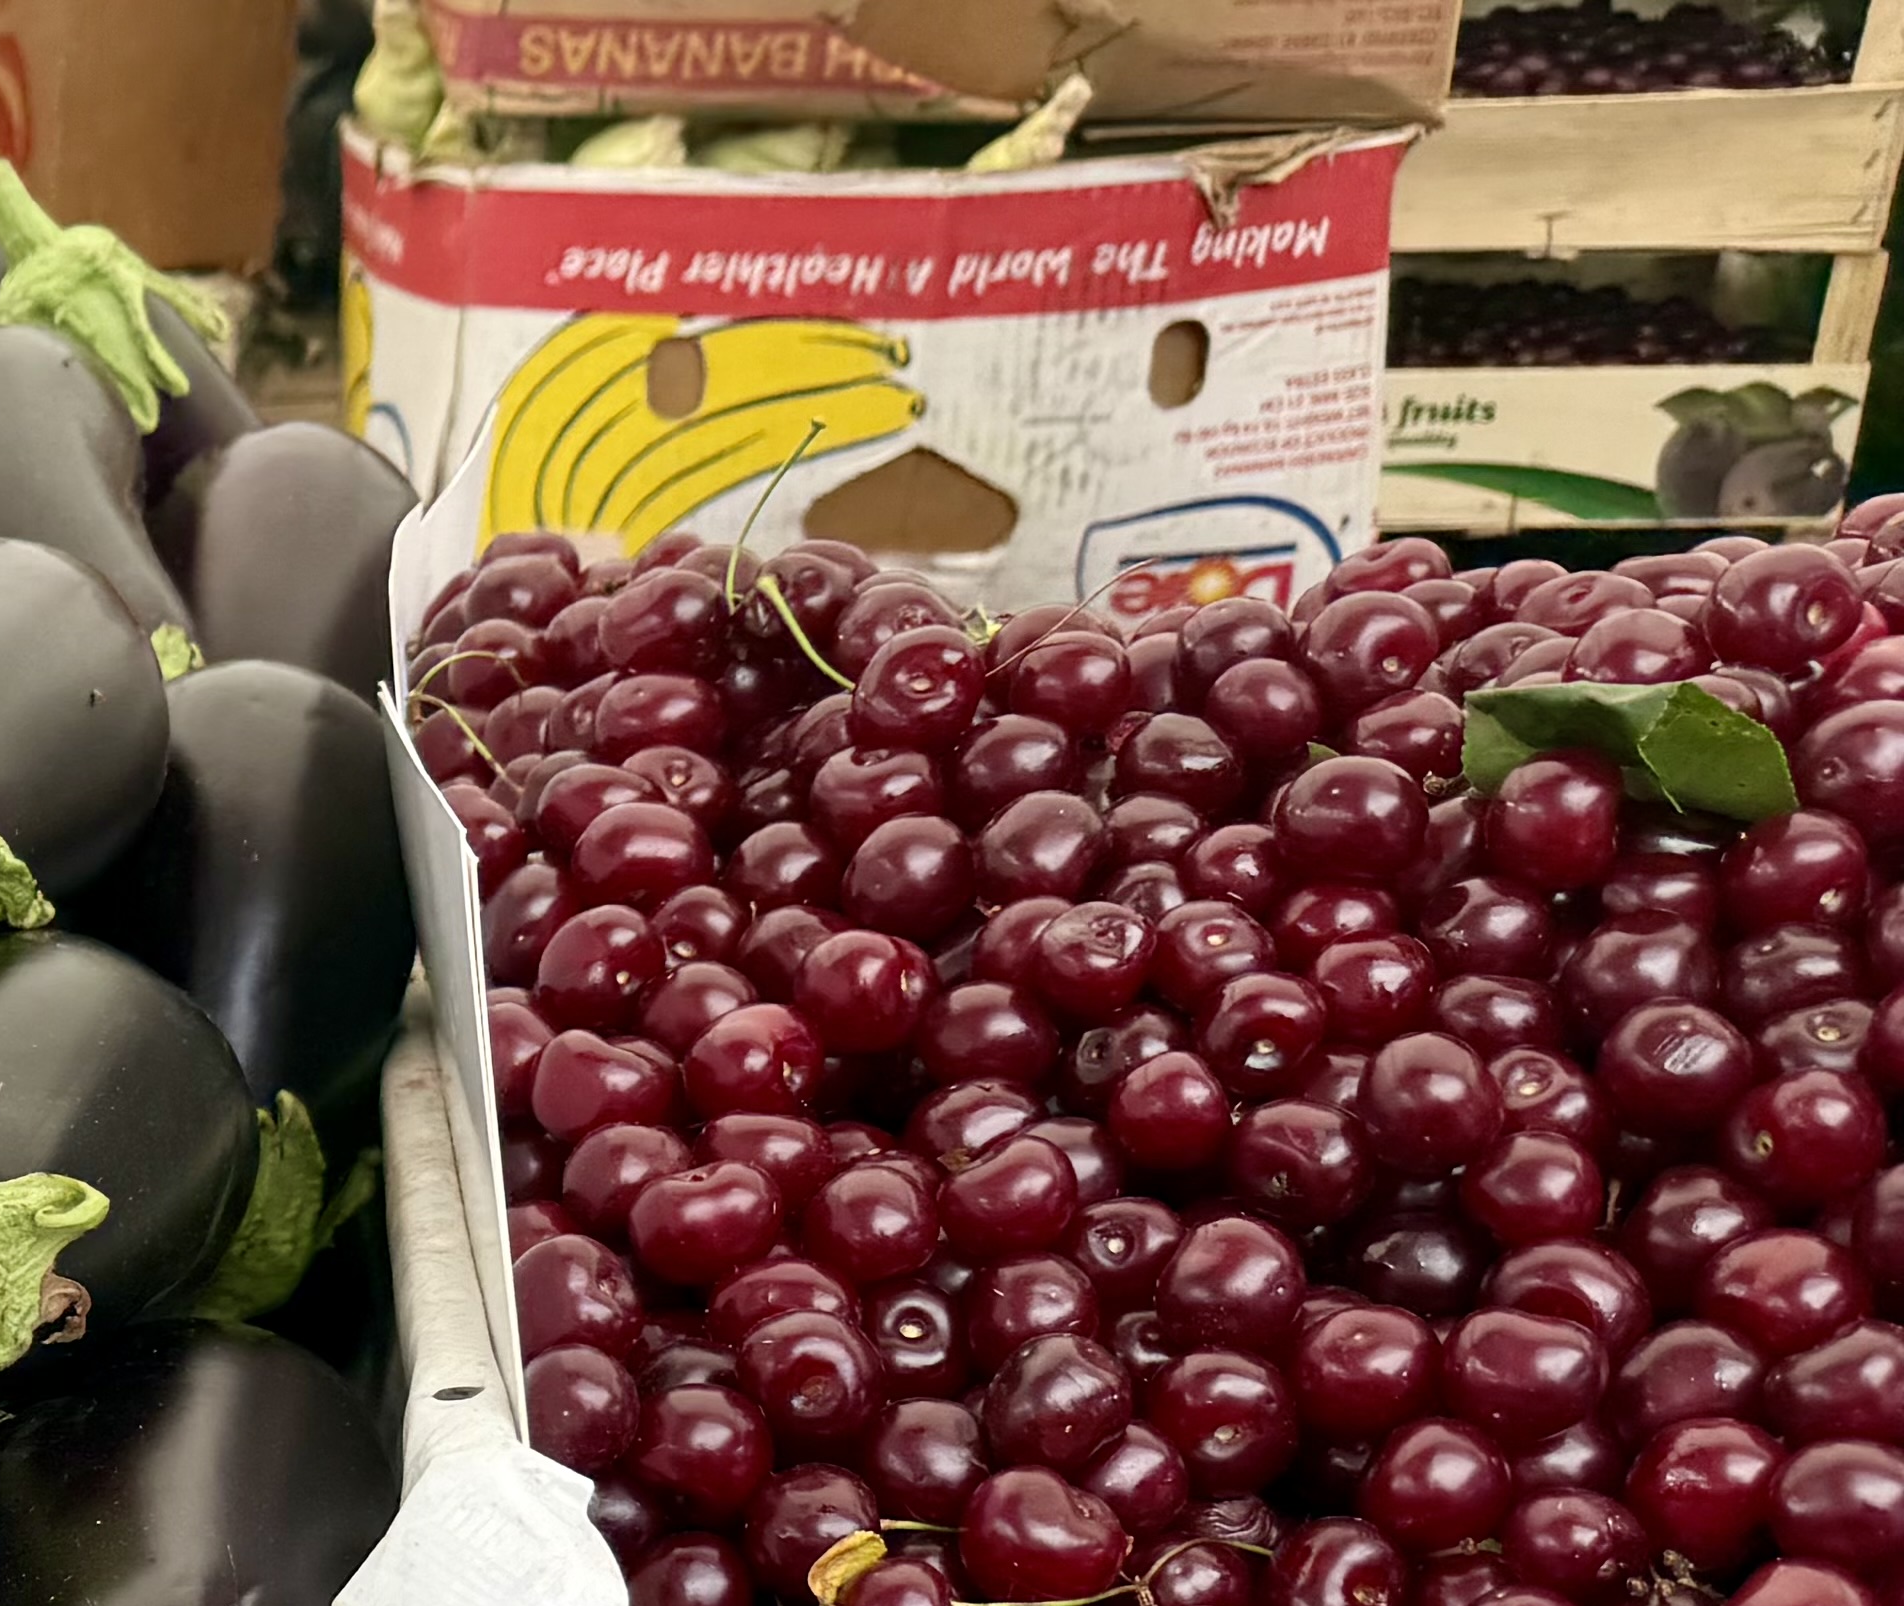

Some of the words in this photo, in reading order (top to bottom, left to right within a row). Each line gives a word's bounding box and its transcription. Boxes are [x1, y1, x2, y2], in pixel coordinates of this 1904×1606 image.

[518, 25, 812, 79] BANANAS
[1092, 240, 1169, 285] The
[1192, 217, 1330, 269] Making
[559, 245, 670, 296] Place
[682, 247, 886, 299] Healthier
[905, 256, 935, 297] A
[949, 246, 1071, 299] World
